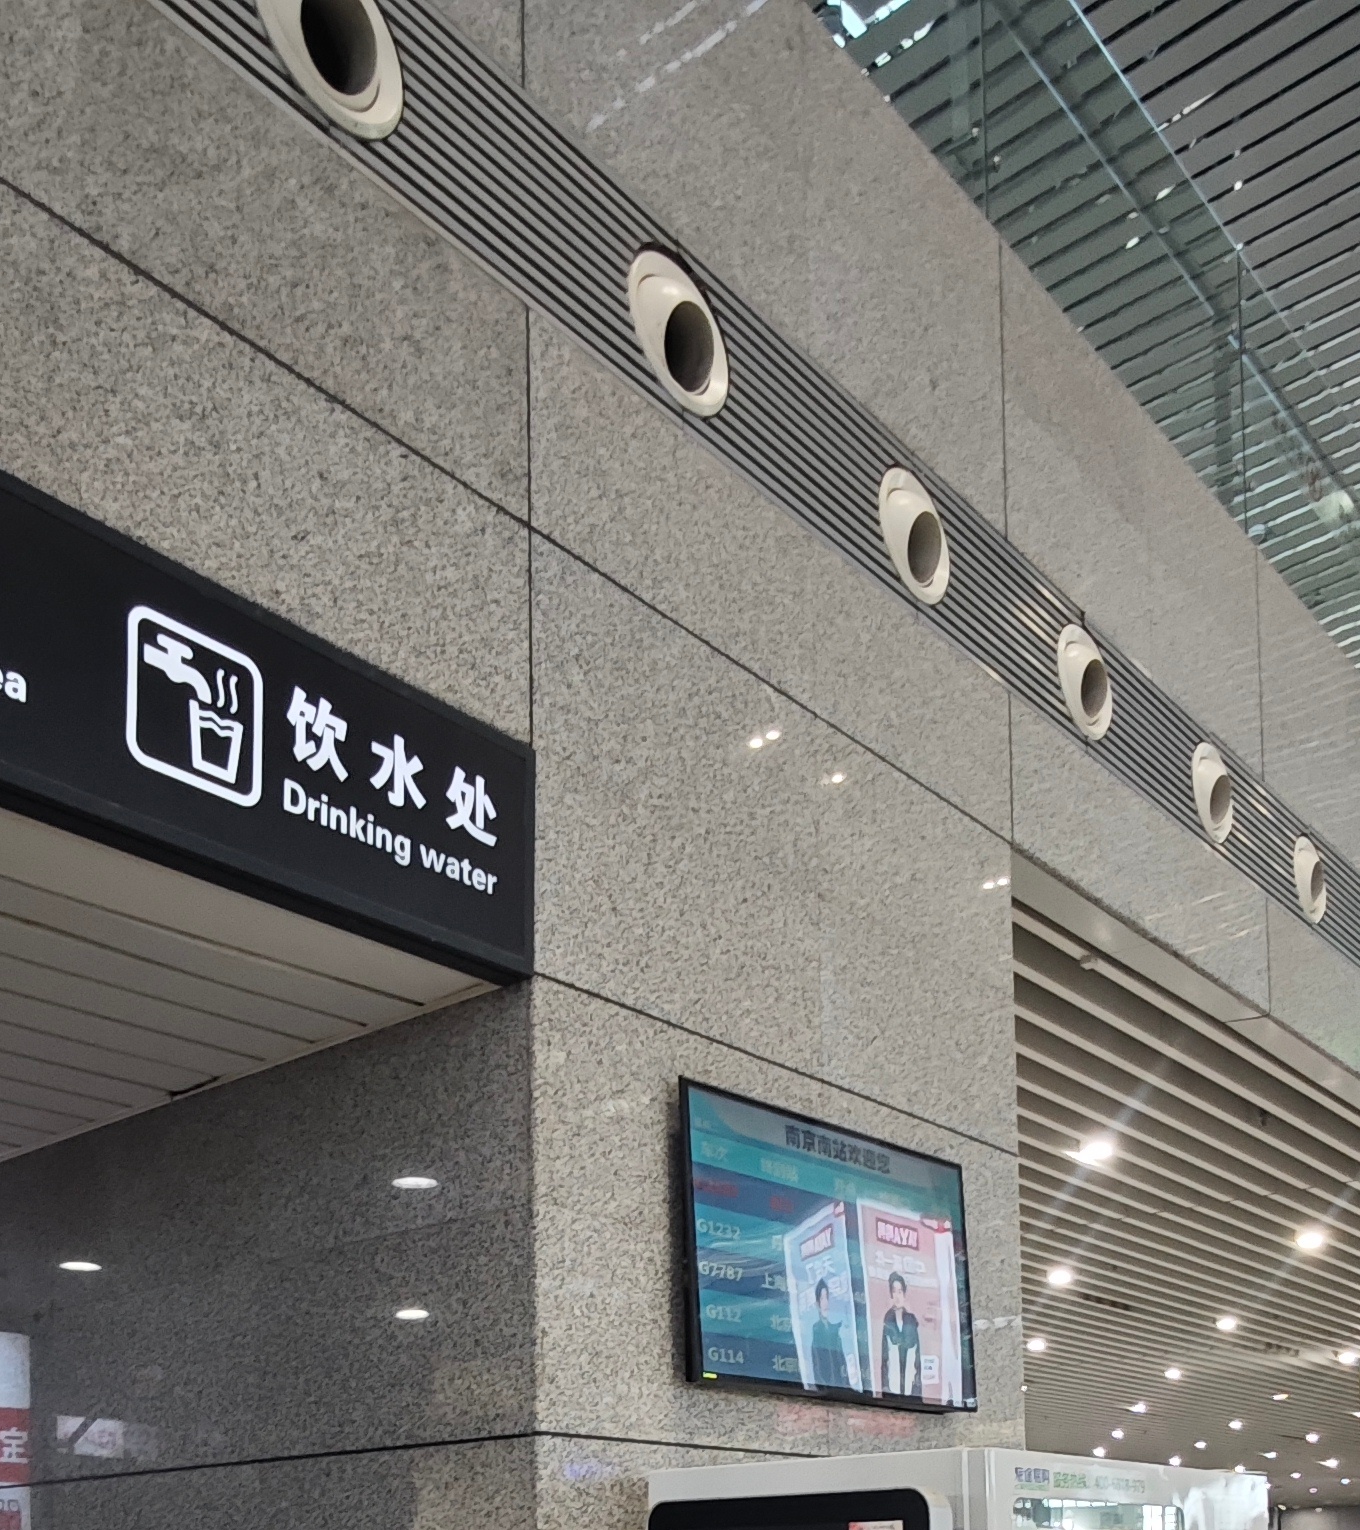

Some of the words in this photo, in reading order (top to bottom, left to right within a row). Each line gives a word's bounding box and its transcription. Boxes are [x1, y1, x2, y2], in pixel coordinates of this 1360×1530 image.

[283, 686, 498, 848] 饮水处
[282, 780, 412, 866] Drinking
[418, 848, 499, 895] water
[708, 1346, 744, 1364] G114
